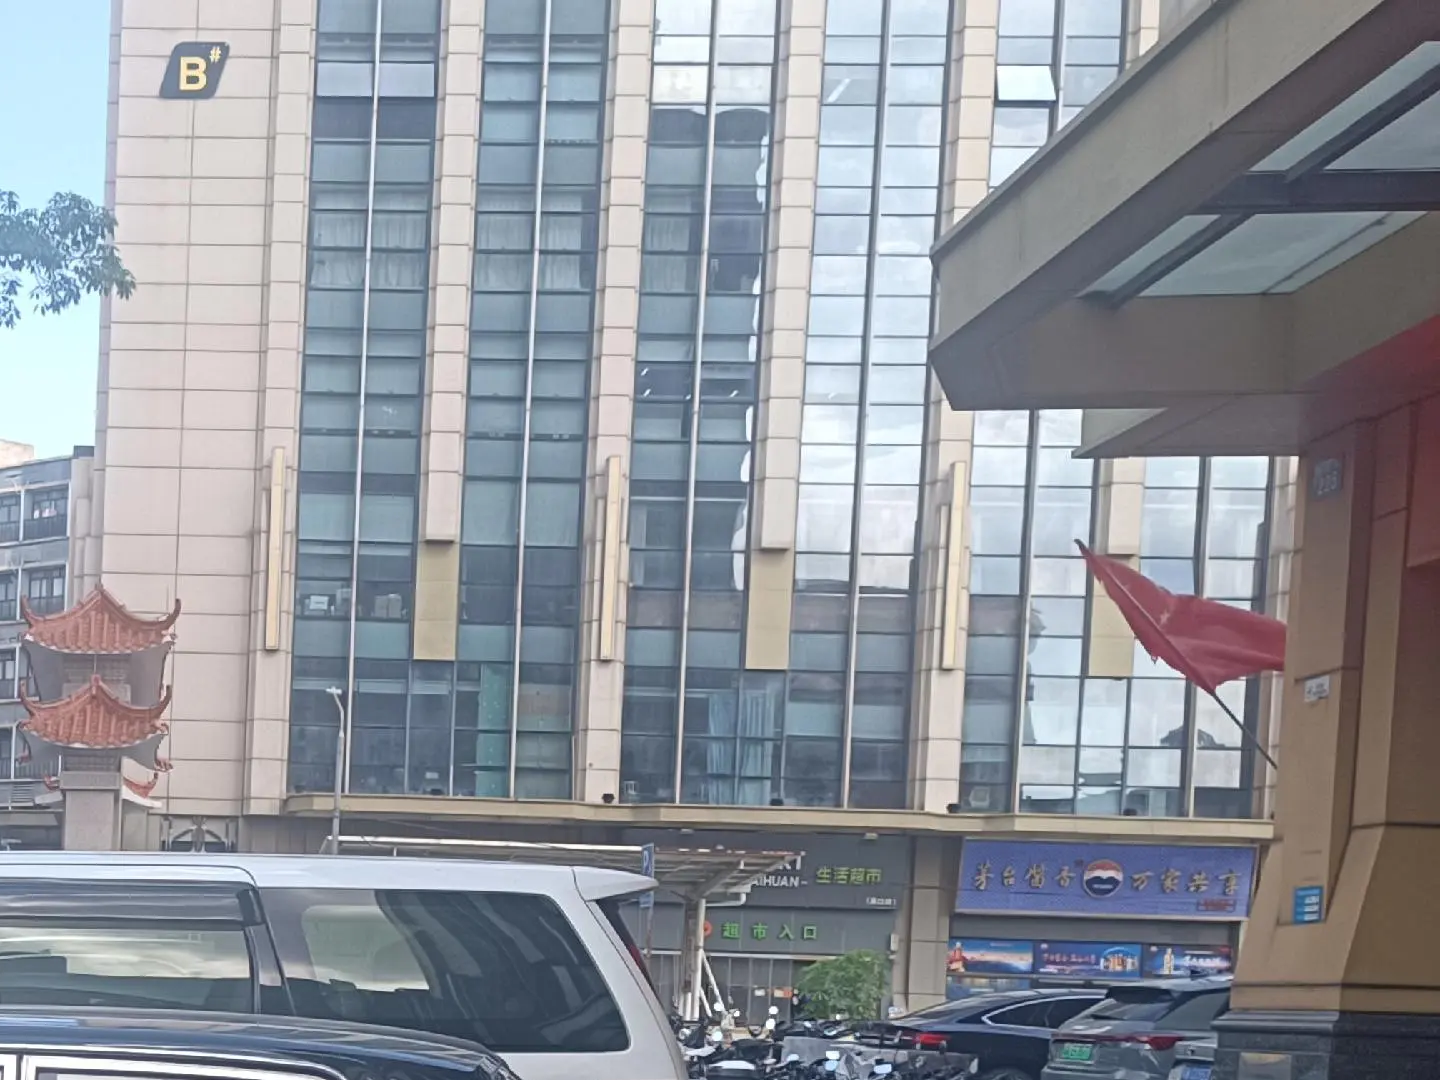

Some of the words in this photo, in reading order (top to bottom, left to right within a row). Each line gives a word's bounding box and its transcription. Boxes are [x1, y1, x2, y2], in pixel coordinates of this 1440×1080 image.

[816, 867, 882, 885] 生活超市
[722, 923, 818, 940] 超市入口
